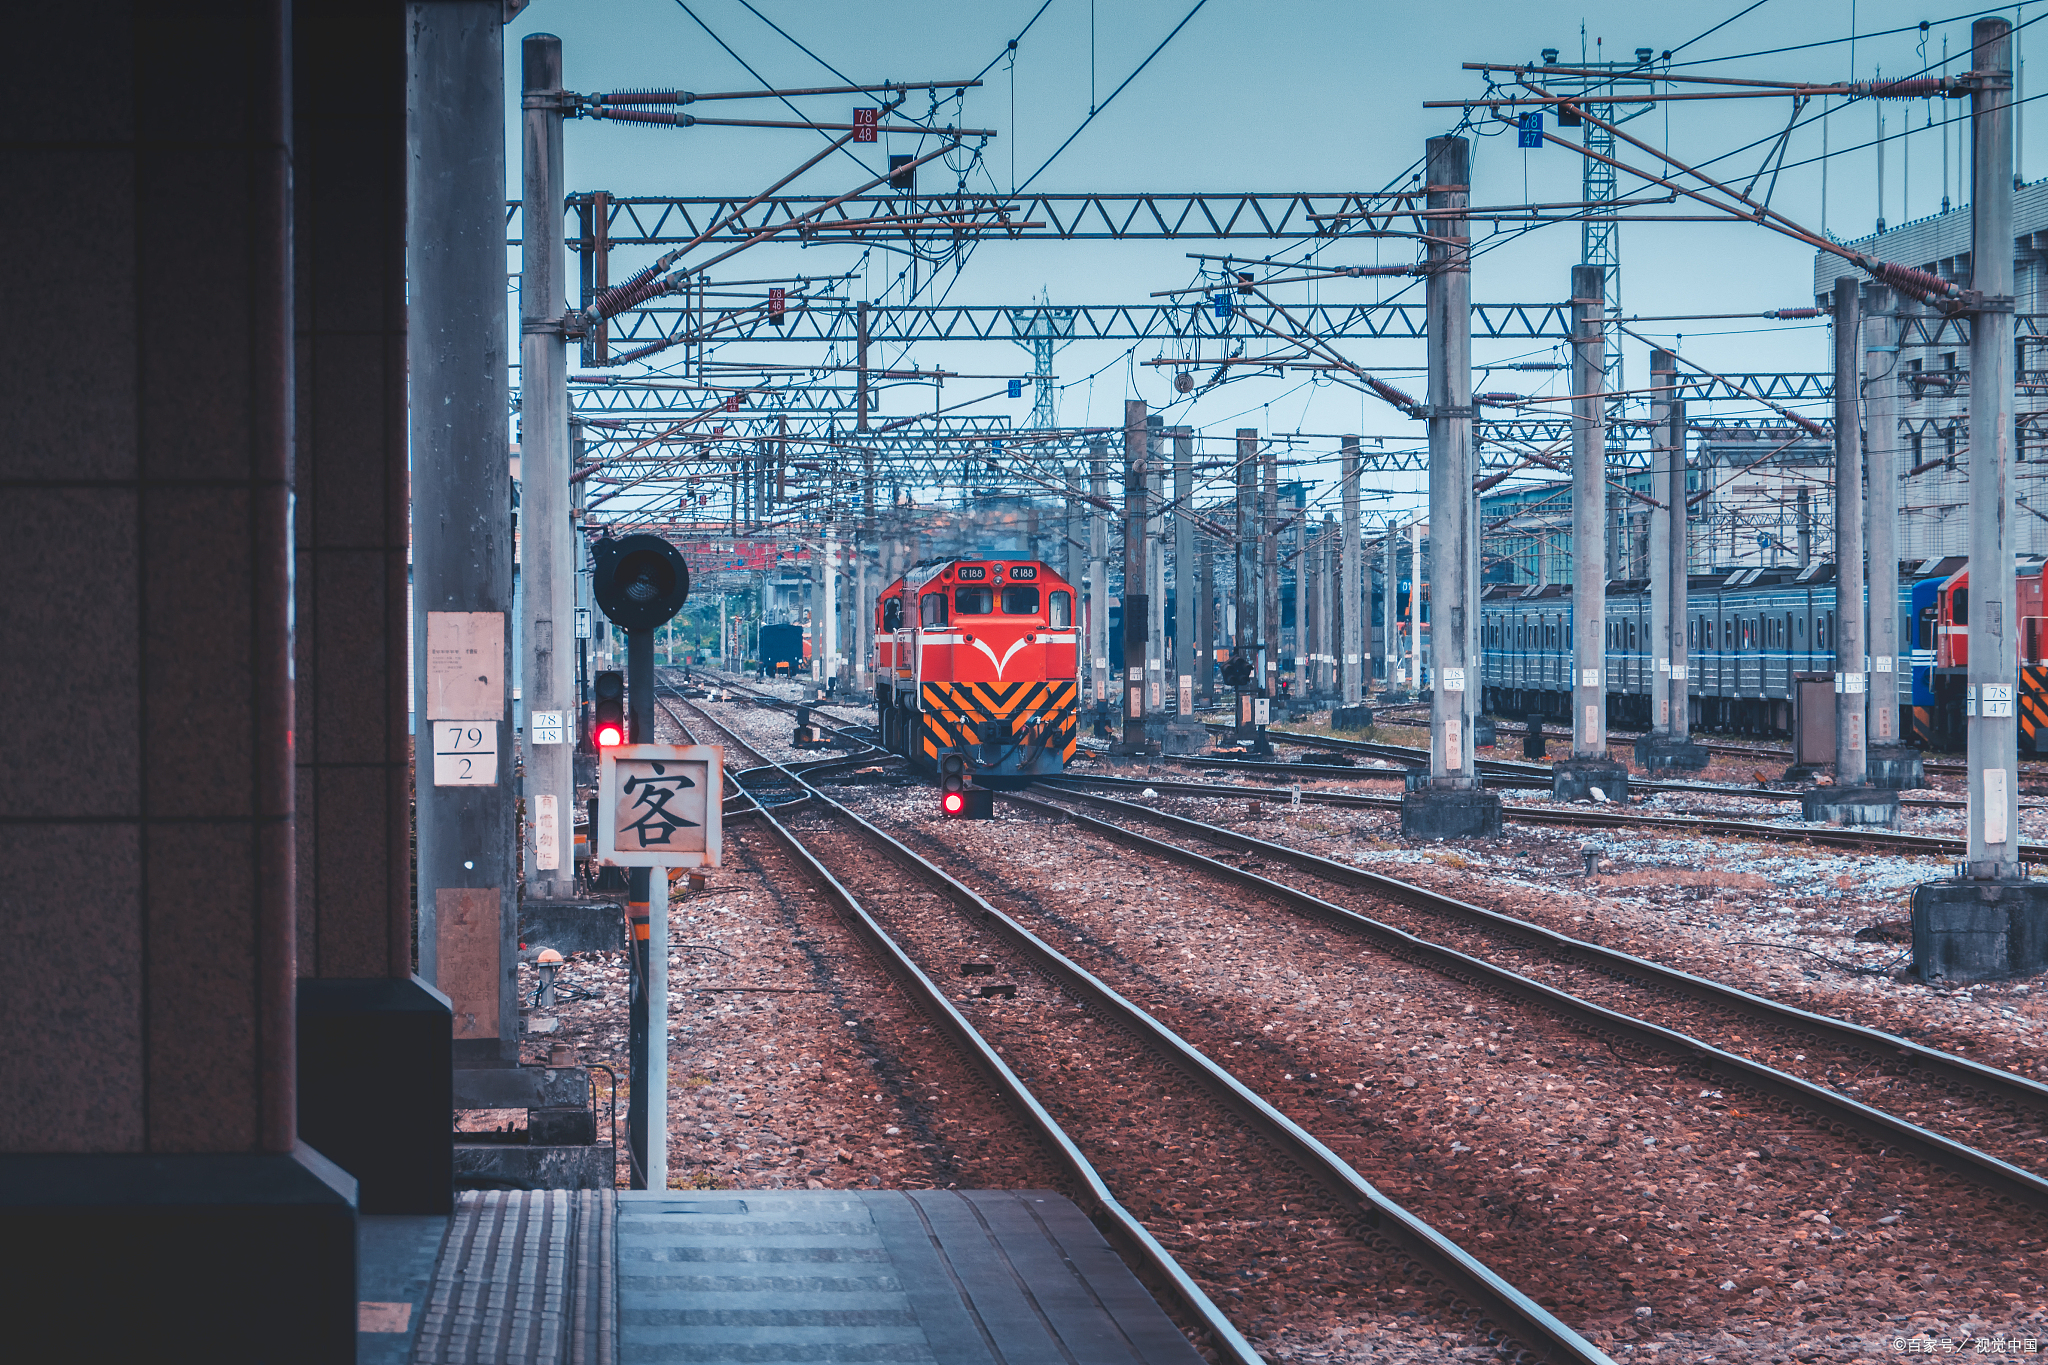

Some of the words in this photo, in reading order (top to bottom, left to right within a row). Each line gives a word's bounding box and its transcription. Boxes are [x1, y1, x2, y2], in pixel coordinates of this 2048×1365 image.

[858, 109, 873, 123] 78
[858, 127, 872, 141] 48
[1524, 133, 1537, 147] 47
[772, 289, 782, 298] 78
[772, 300, 782, 310] 46
[961, 569, 967, 578] R
[969, 569, 982, 578] 188
[1012, 569, 1018, 577] R
[1020, 569, 1033, 577] 188
[1990, 687, 2007, 698] 78
[1989, 703, 2007, 713] 47
[539, 714, 556, 725] 78
[448, 727, 483, 749] 79
[538, 730, 556, 741] 48
[458, 758, 473, 779] 2
[619, 762, 701, 848] 客
